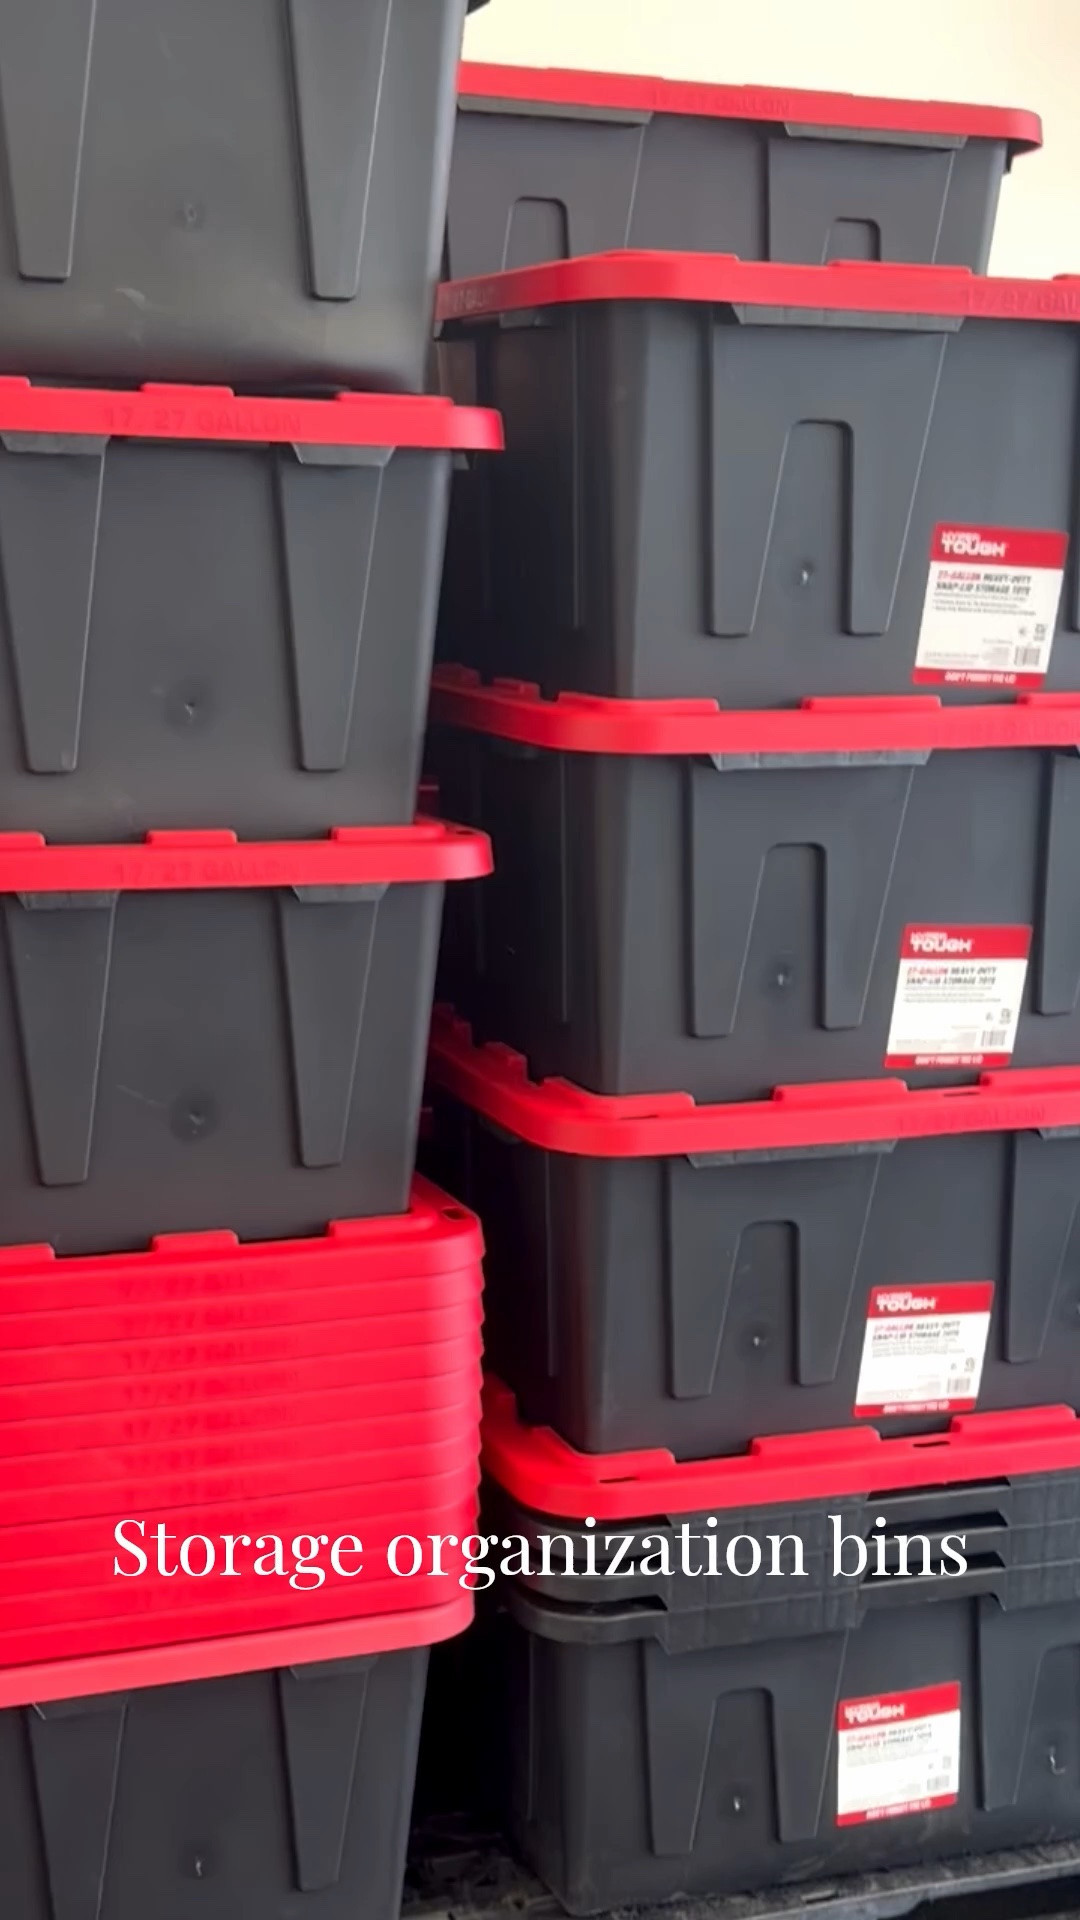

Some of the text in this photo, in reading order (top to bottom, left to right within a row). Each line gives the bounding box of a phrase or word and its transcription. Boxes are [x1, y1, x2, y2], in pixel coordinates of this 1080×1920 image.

[197, 407, 301, 434] GALLON
[943, 541, 1006, 557] TOUGH
[912, 938, 973, 952] TOUGH
[877, 1297, 936, 1312] TOUGH
[846, 1704, 905, 1723] TOUGH
